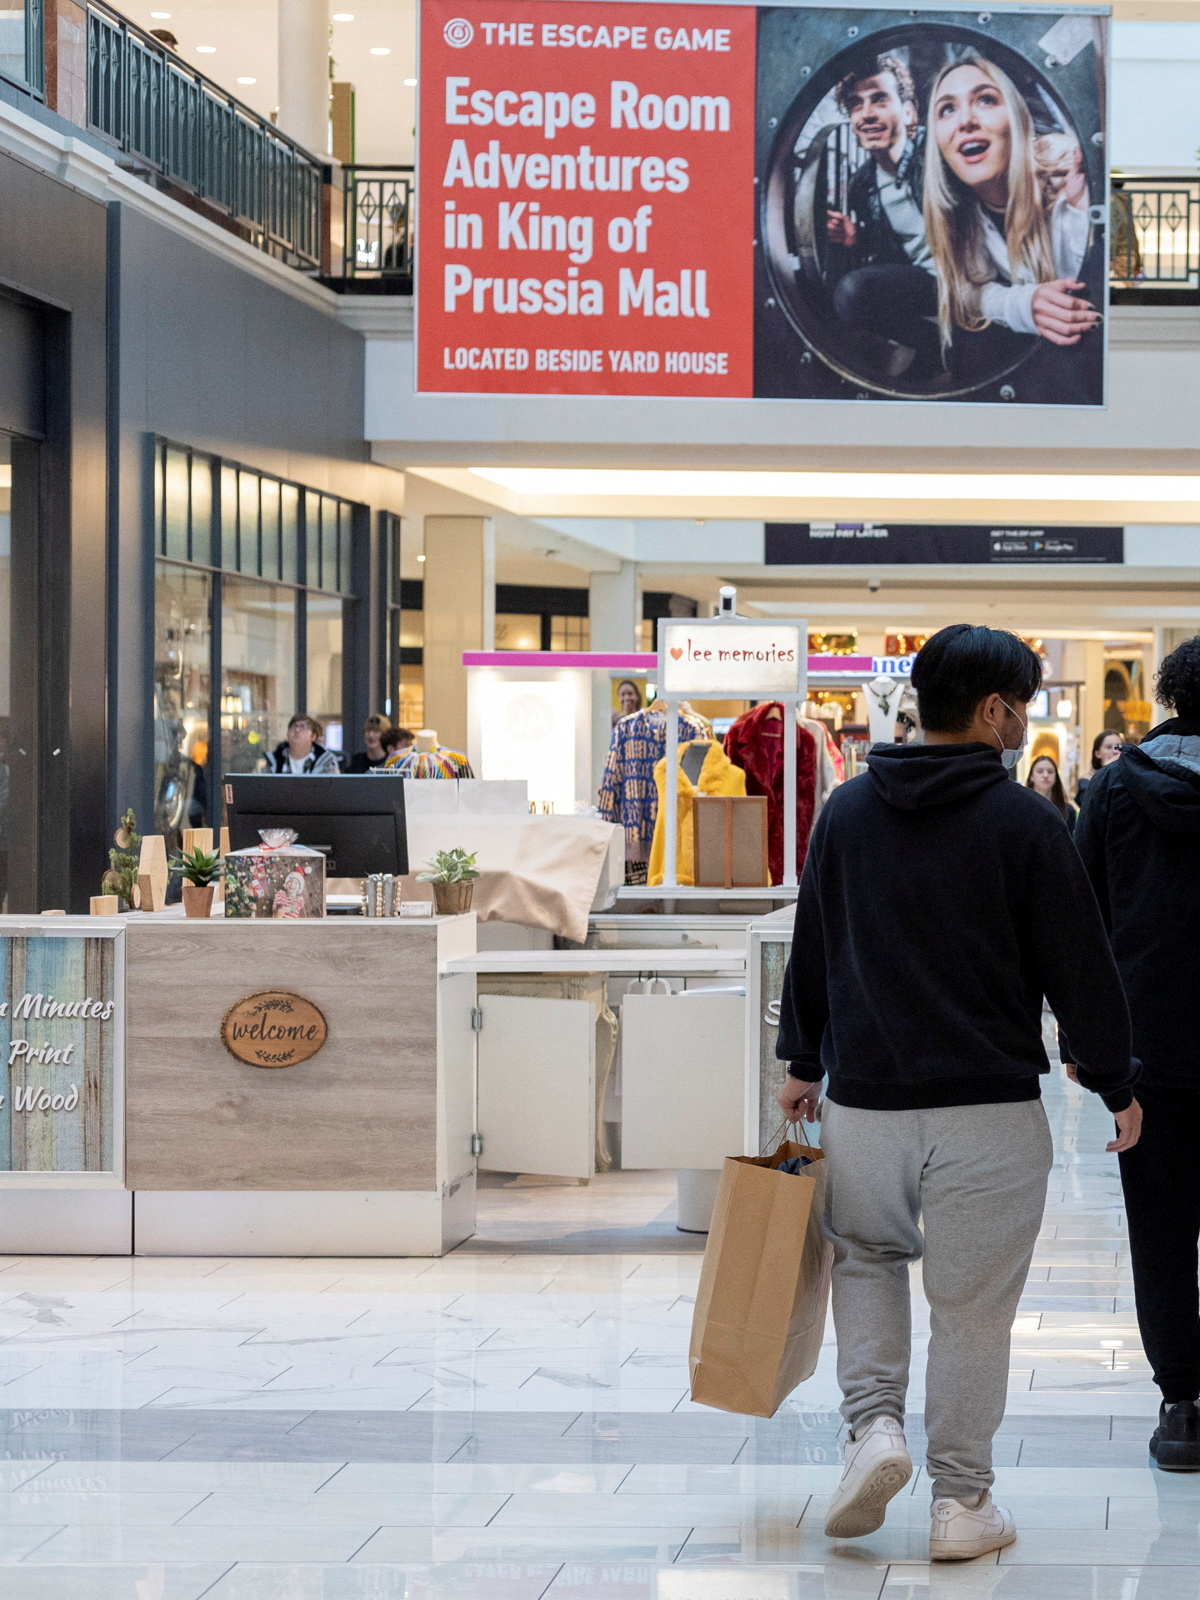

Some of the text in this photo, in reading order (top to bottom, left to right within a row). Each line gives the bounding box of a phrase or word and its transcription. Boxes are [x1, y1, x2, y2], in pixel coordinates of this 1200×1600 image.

[480, 22, 732, 52] THE ESCAPE GAME
[445, 76, 731, 138] Escape Room
[443, 138, 690, 193] Adventures
[444, 200, 653, 264] in King of
[444, 263, 710, 318] Prussia Mall
[443, 347, 729, 375] LOCATED BESIDE YARD HOUSE
[687, 638, 795, 663] lee memories
[12, 993, 115, 1020] Minutes
[232, 1012, 320, 1041] welcome
[8, 1039, 74, 1066] Print
[15, 1083, 79, 1112] Wood
